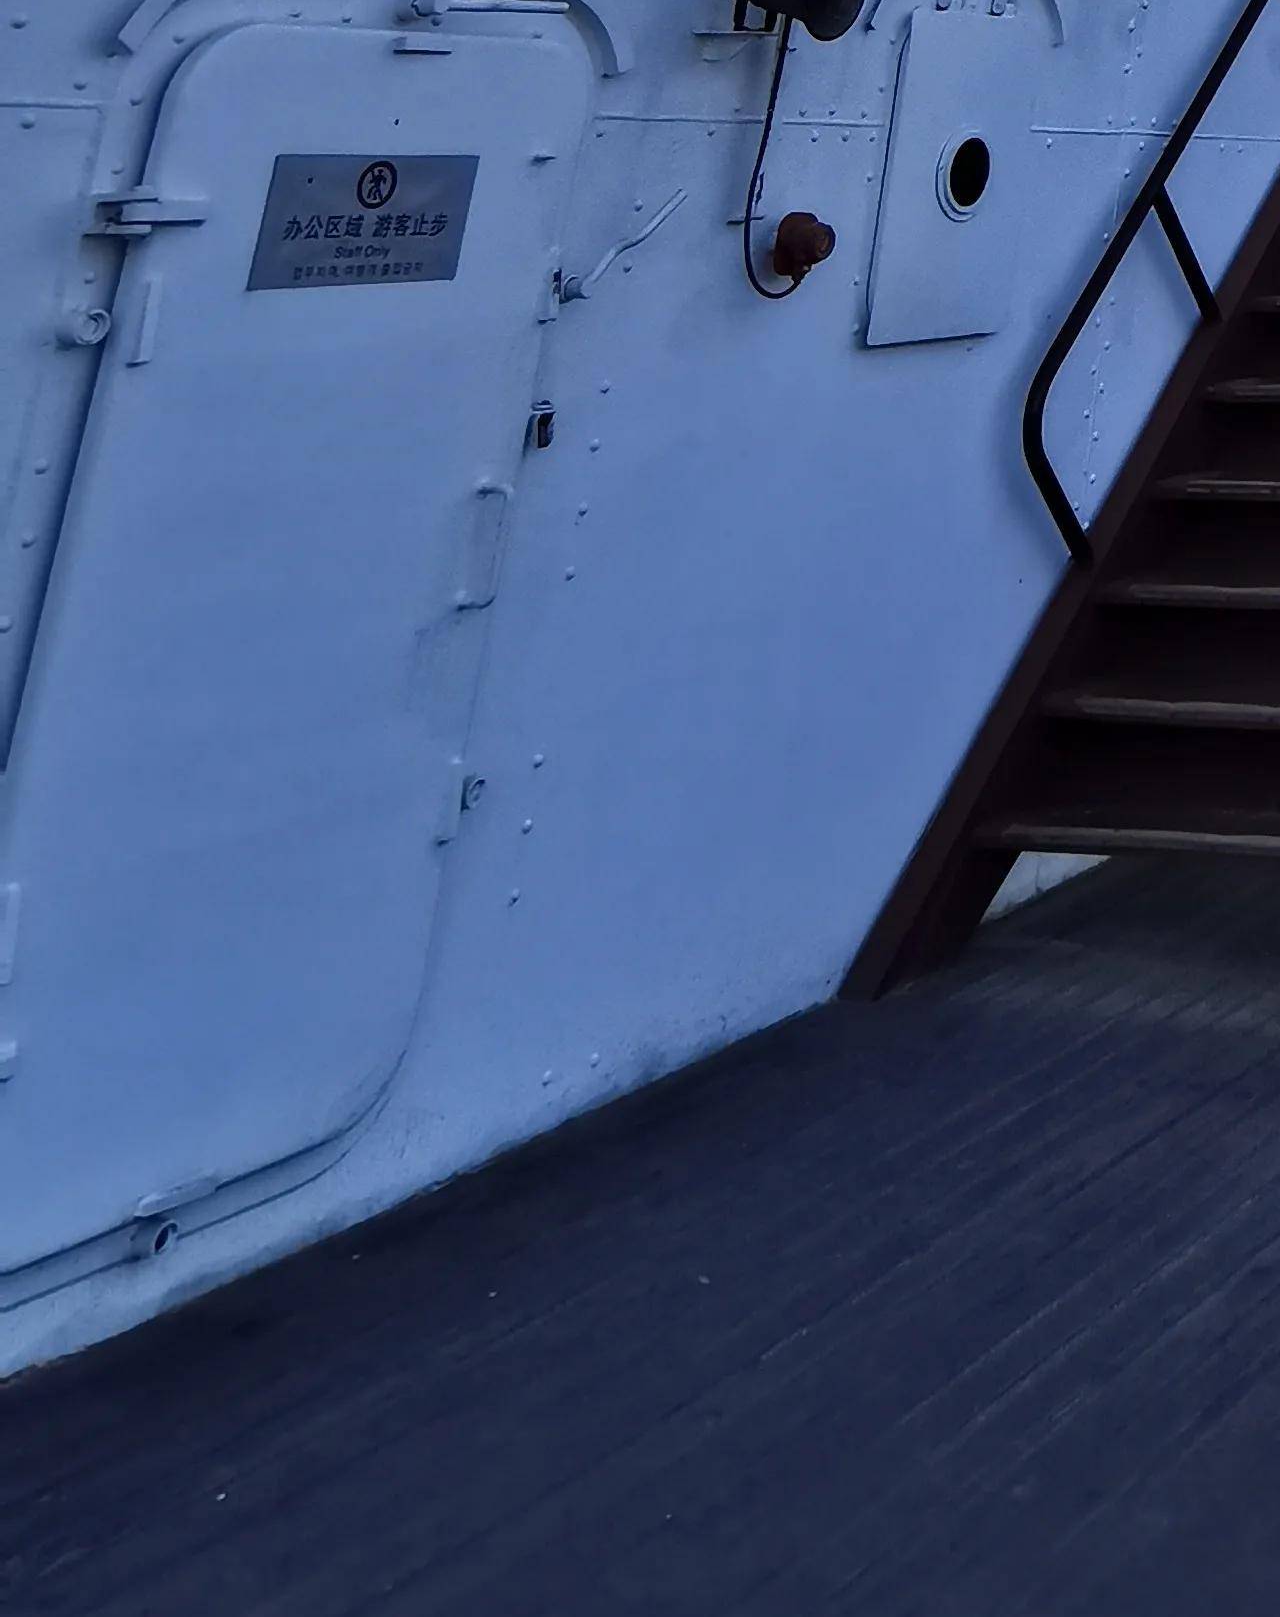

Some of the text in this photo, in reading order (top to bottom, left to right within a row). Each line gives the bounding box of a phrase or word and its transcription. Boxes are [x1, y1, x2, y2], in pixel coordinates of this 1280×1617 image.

[283, 213, 448, 241] 办公区域 游客止步
[334, 245, 391, 259] Staff Only
